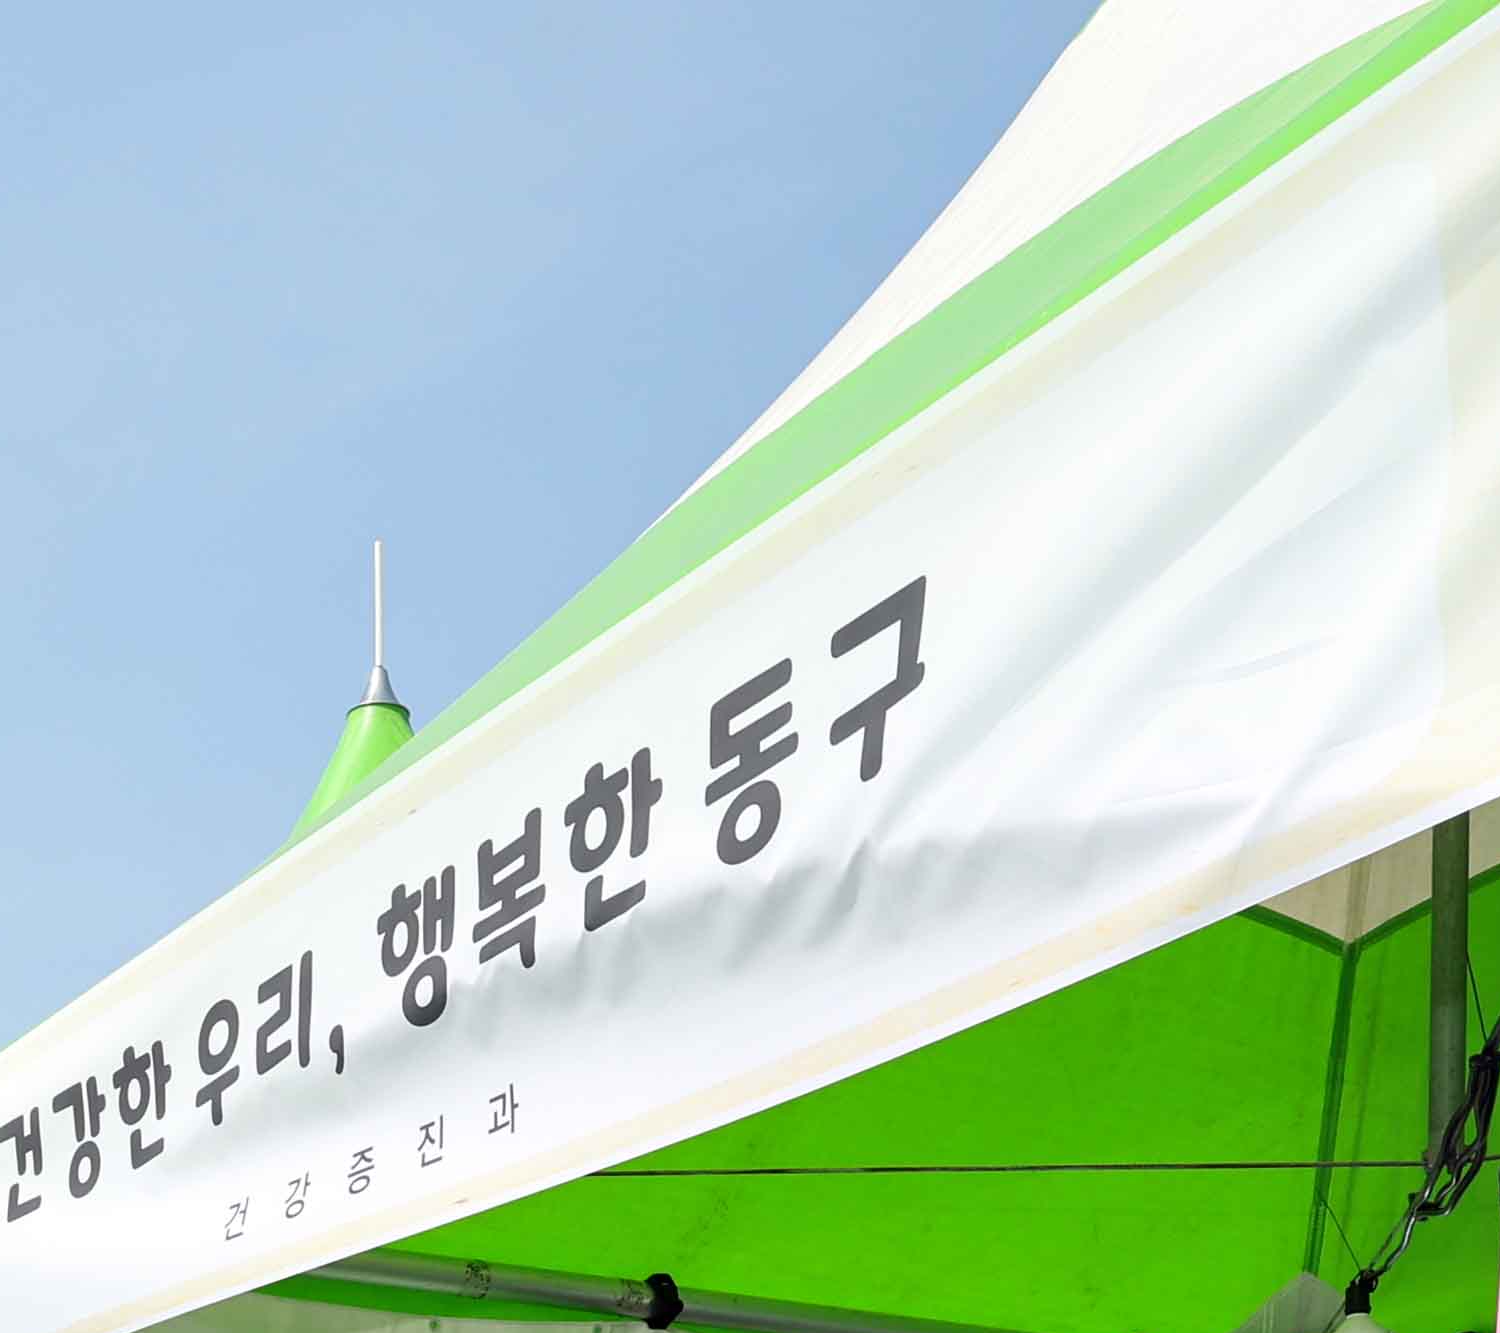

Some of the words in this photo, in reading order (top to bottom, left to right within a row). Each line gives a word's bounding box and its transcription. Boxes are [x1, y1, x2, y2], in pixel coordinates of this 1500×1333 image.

[195, 948, 348, 1129] 우리,
[376, 746, 663, 1028] 행복한
[704, 574, 929, 866] 동구
